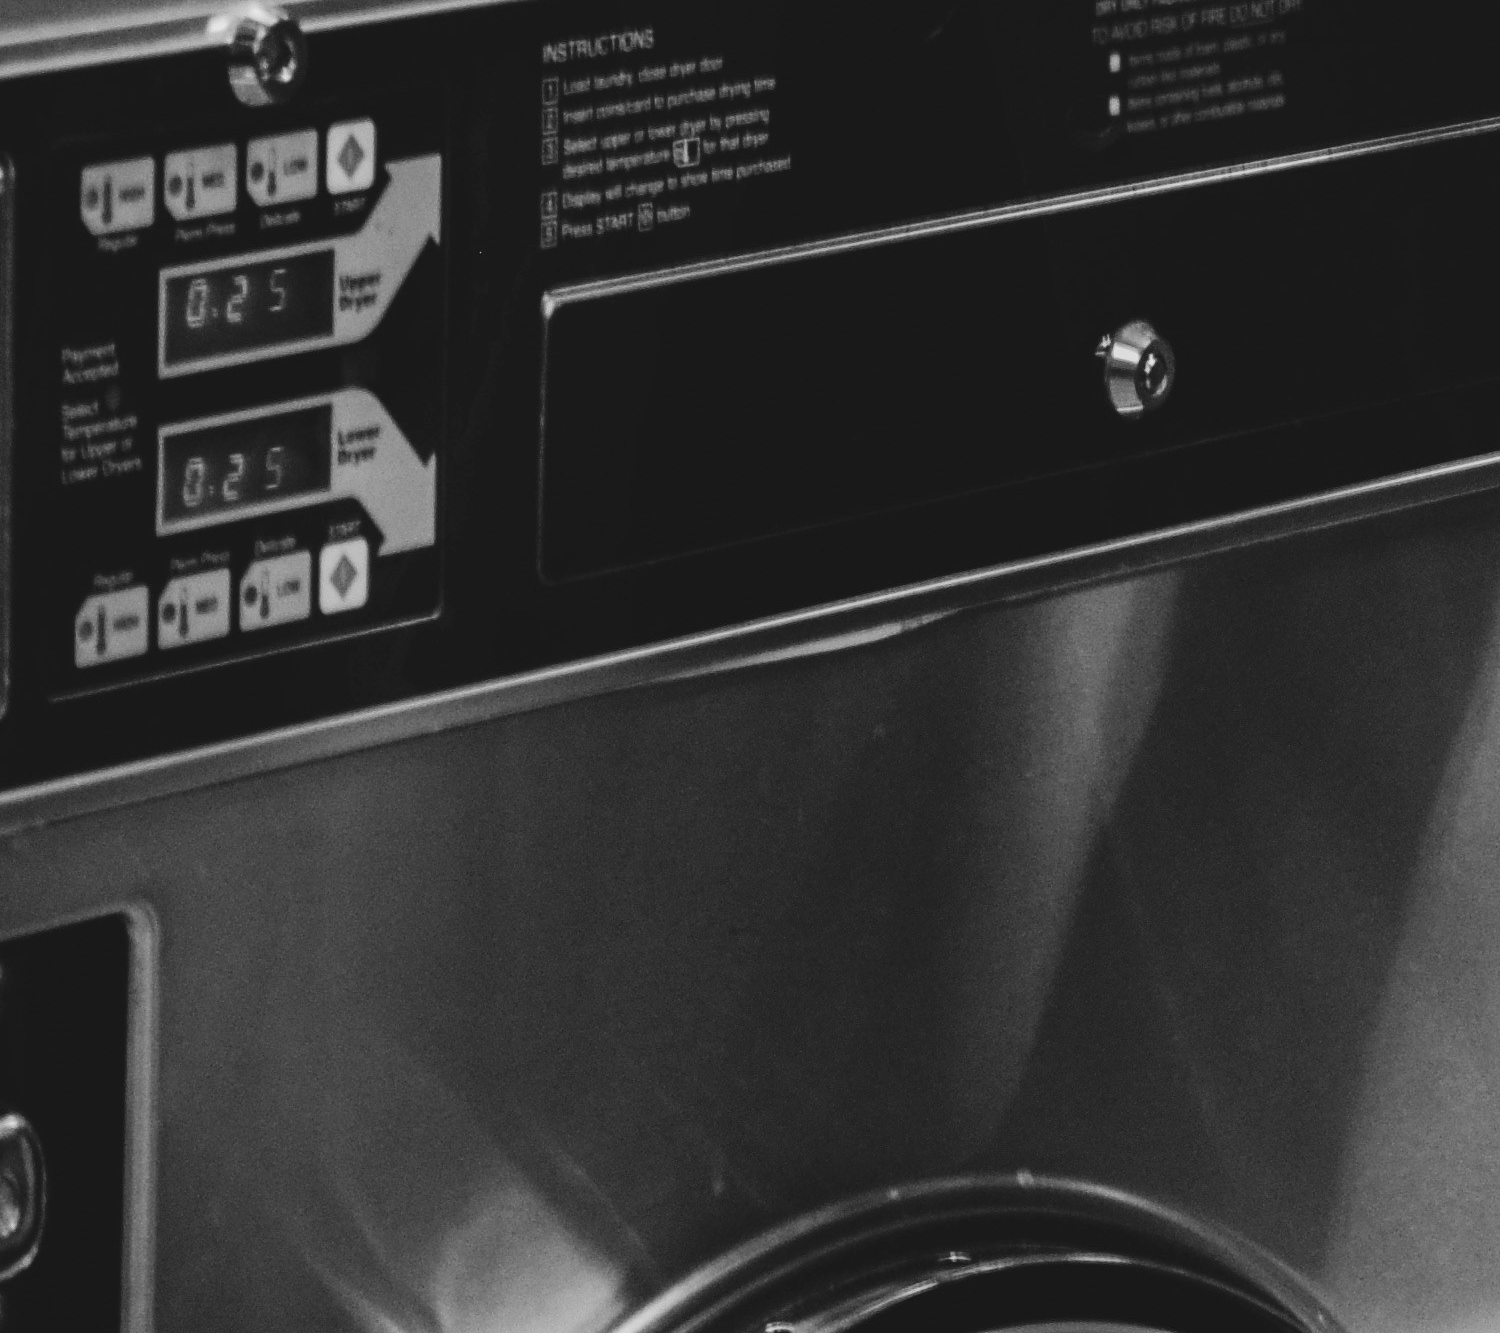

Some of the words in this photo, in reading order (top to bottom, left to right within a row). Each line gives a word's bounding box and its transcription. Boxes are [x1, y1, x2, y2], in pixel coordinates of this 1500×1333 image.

[542, 26, 655, 64] INSTRUCTIONS
[188, 268, 287, 329] 0.25
[183, 445, 284, 508] 0.25
